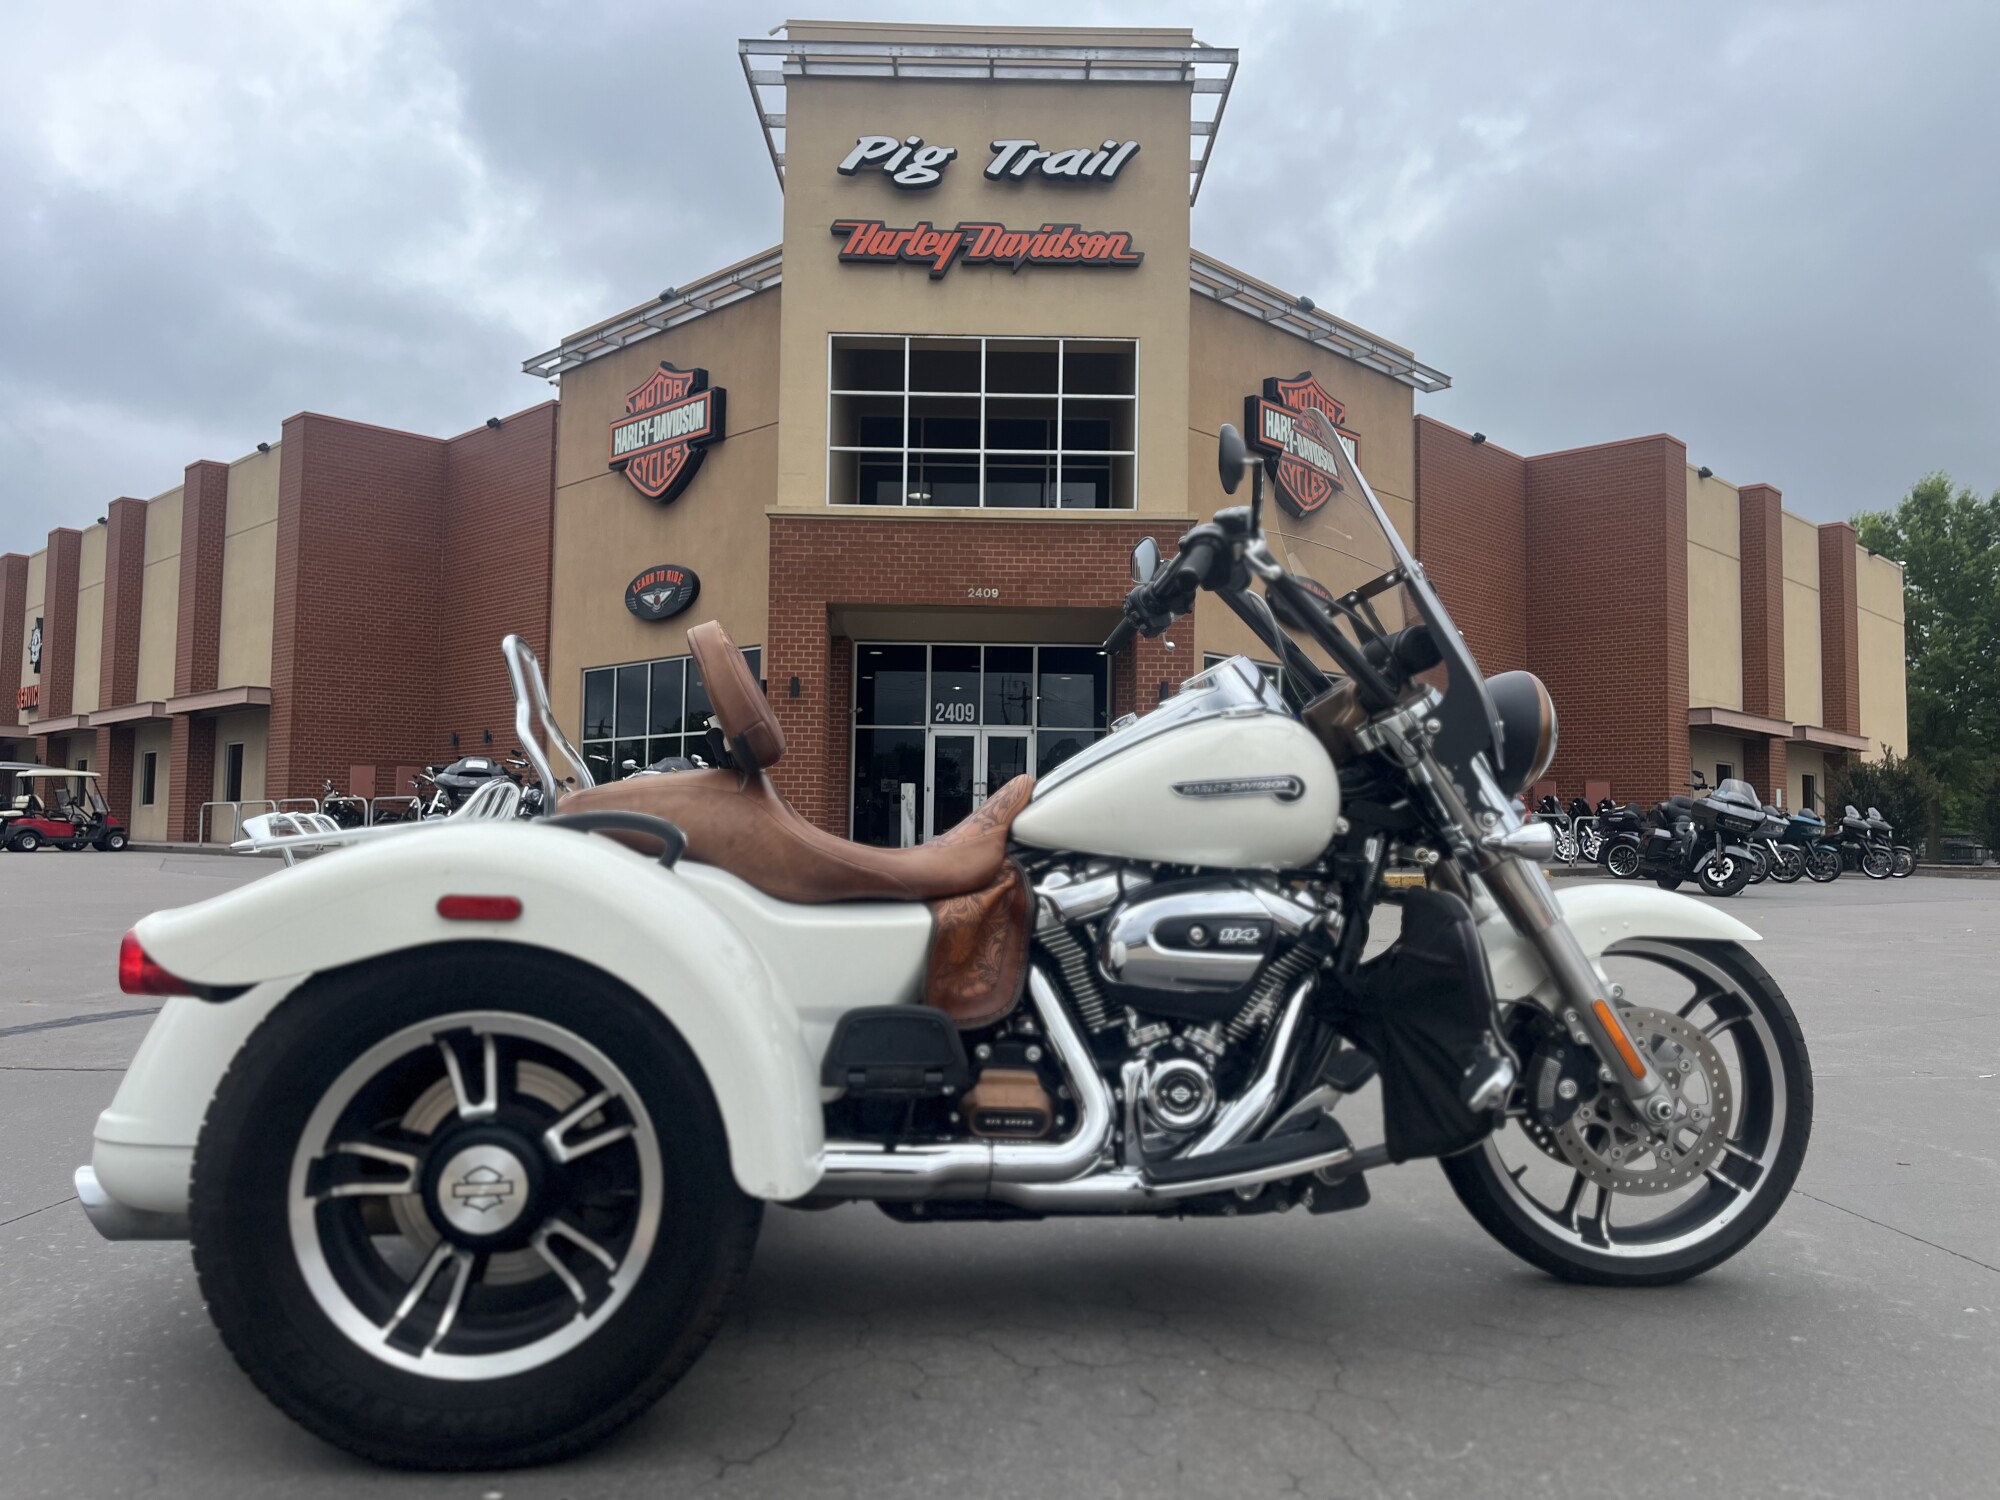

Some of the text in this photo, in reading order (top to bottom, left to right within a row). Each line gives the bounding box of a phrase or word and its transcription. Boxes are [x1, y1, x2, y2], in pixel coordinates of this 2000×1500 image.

[838, 135, 1139, 187] Pig Trail
[834, 221, 1140, 271] Harley-Davidson
[635, 376, 683, 413] MOTOR
[613, 401, 705, 456] HARLEY-DAVIDSON
[633, 444, 682, 488] CYCLES
[1281, 460, 1325, 501] CYCLES
[632, 569, 684, 595] LEARN TO RIDE
[967, 587, 999, 598] 2409
[17, 684, 40, 710] SERVIC
[935, 702, 975, 722] 2409
[1183, 780, 1290, 795] HARLEY-DAVIDSON
[1219, 928, 1260, 941] 114
